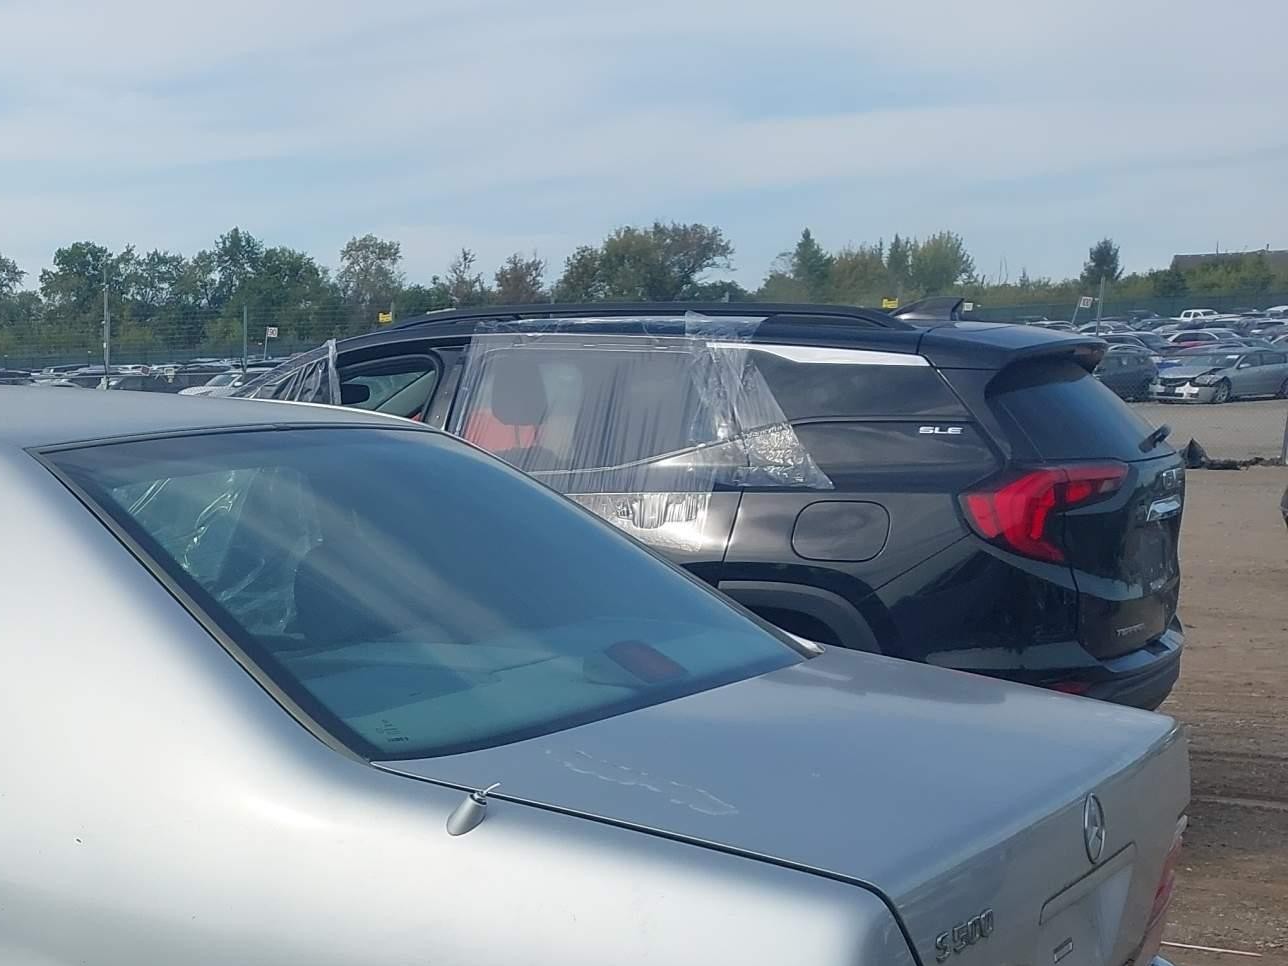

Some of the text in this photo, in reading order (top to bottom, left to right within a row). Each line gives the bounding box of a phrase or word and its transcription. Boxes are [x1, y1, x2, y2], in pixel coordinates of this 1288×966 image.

[919, 426, 963, 435] SLE
[935, 907, 994, 963] S 500
